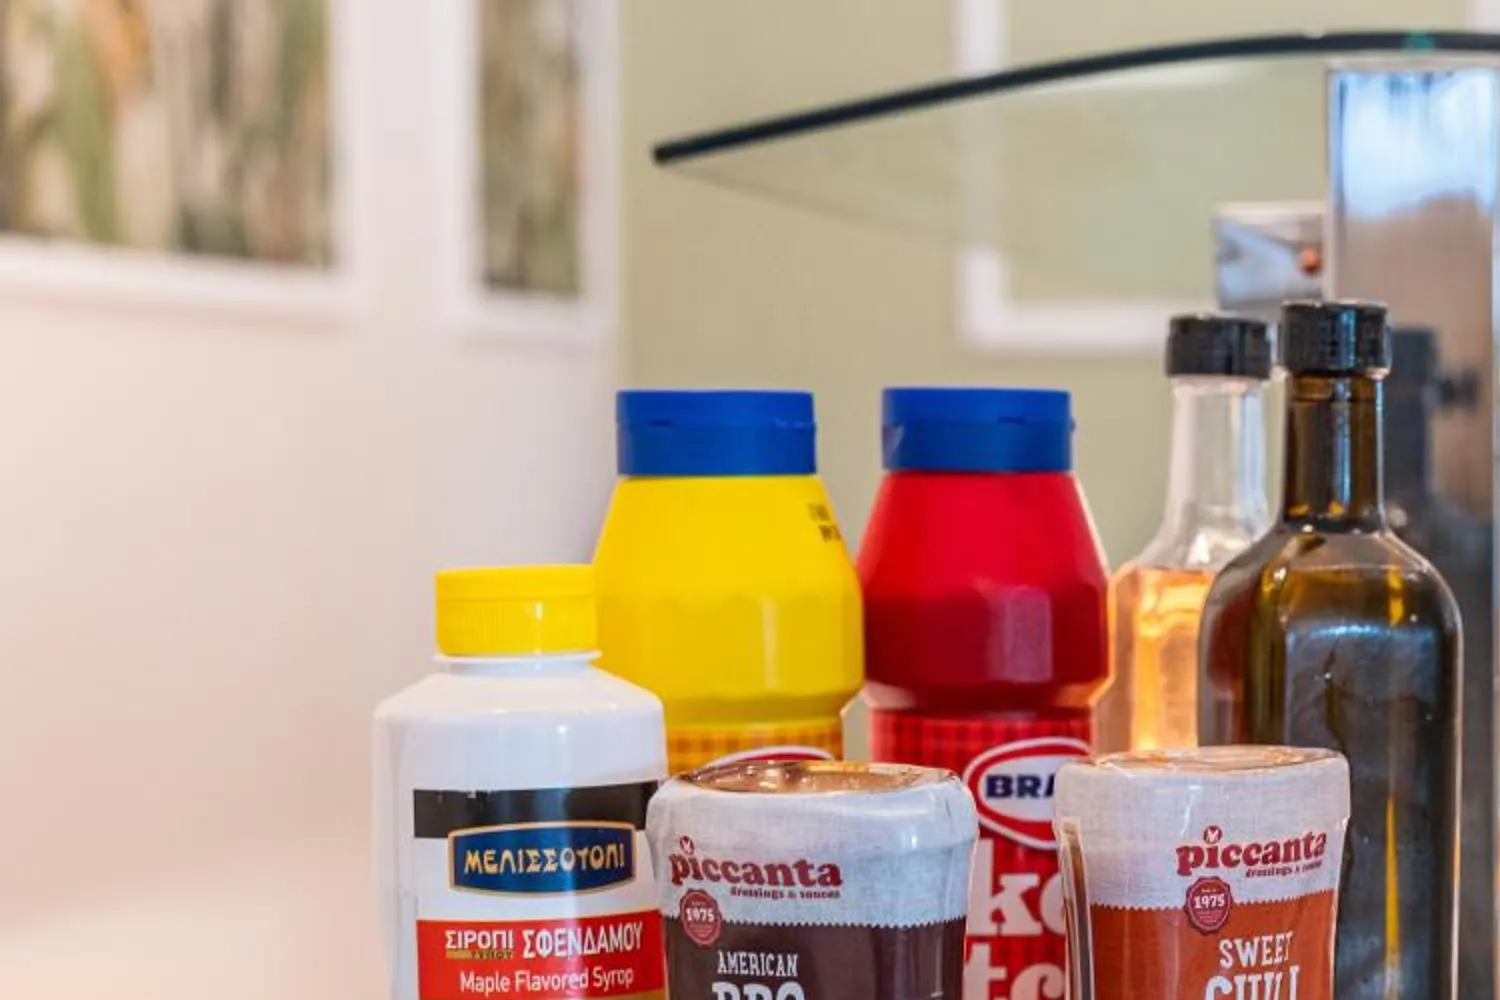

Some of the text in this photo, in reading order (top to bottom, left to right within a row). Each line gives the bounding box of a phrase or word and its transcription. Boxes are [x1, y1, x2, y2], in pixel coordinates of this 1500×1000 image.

[668, 836, 843, 887] piccanta
[1176, 826, 1327, 877] piccanta
[685, 906, 716, 923] 1975
[1193, 893, 1226, 910] 1975
[446, 922, 644, 960] ΣΙΡΟΠΙ ΣΦΕΝΔΑΜΟΥ
[1219, 931, 1294, 969] SWEET
[717, 951, 799, 977] AMERICAN
[460, 971, 511, 998] Maple
[515, 967, 589, 993] Flavored
